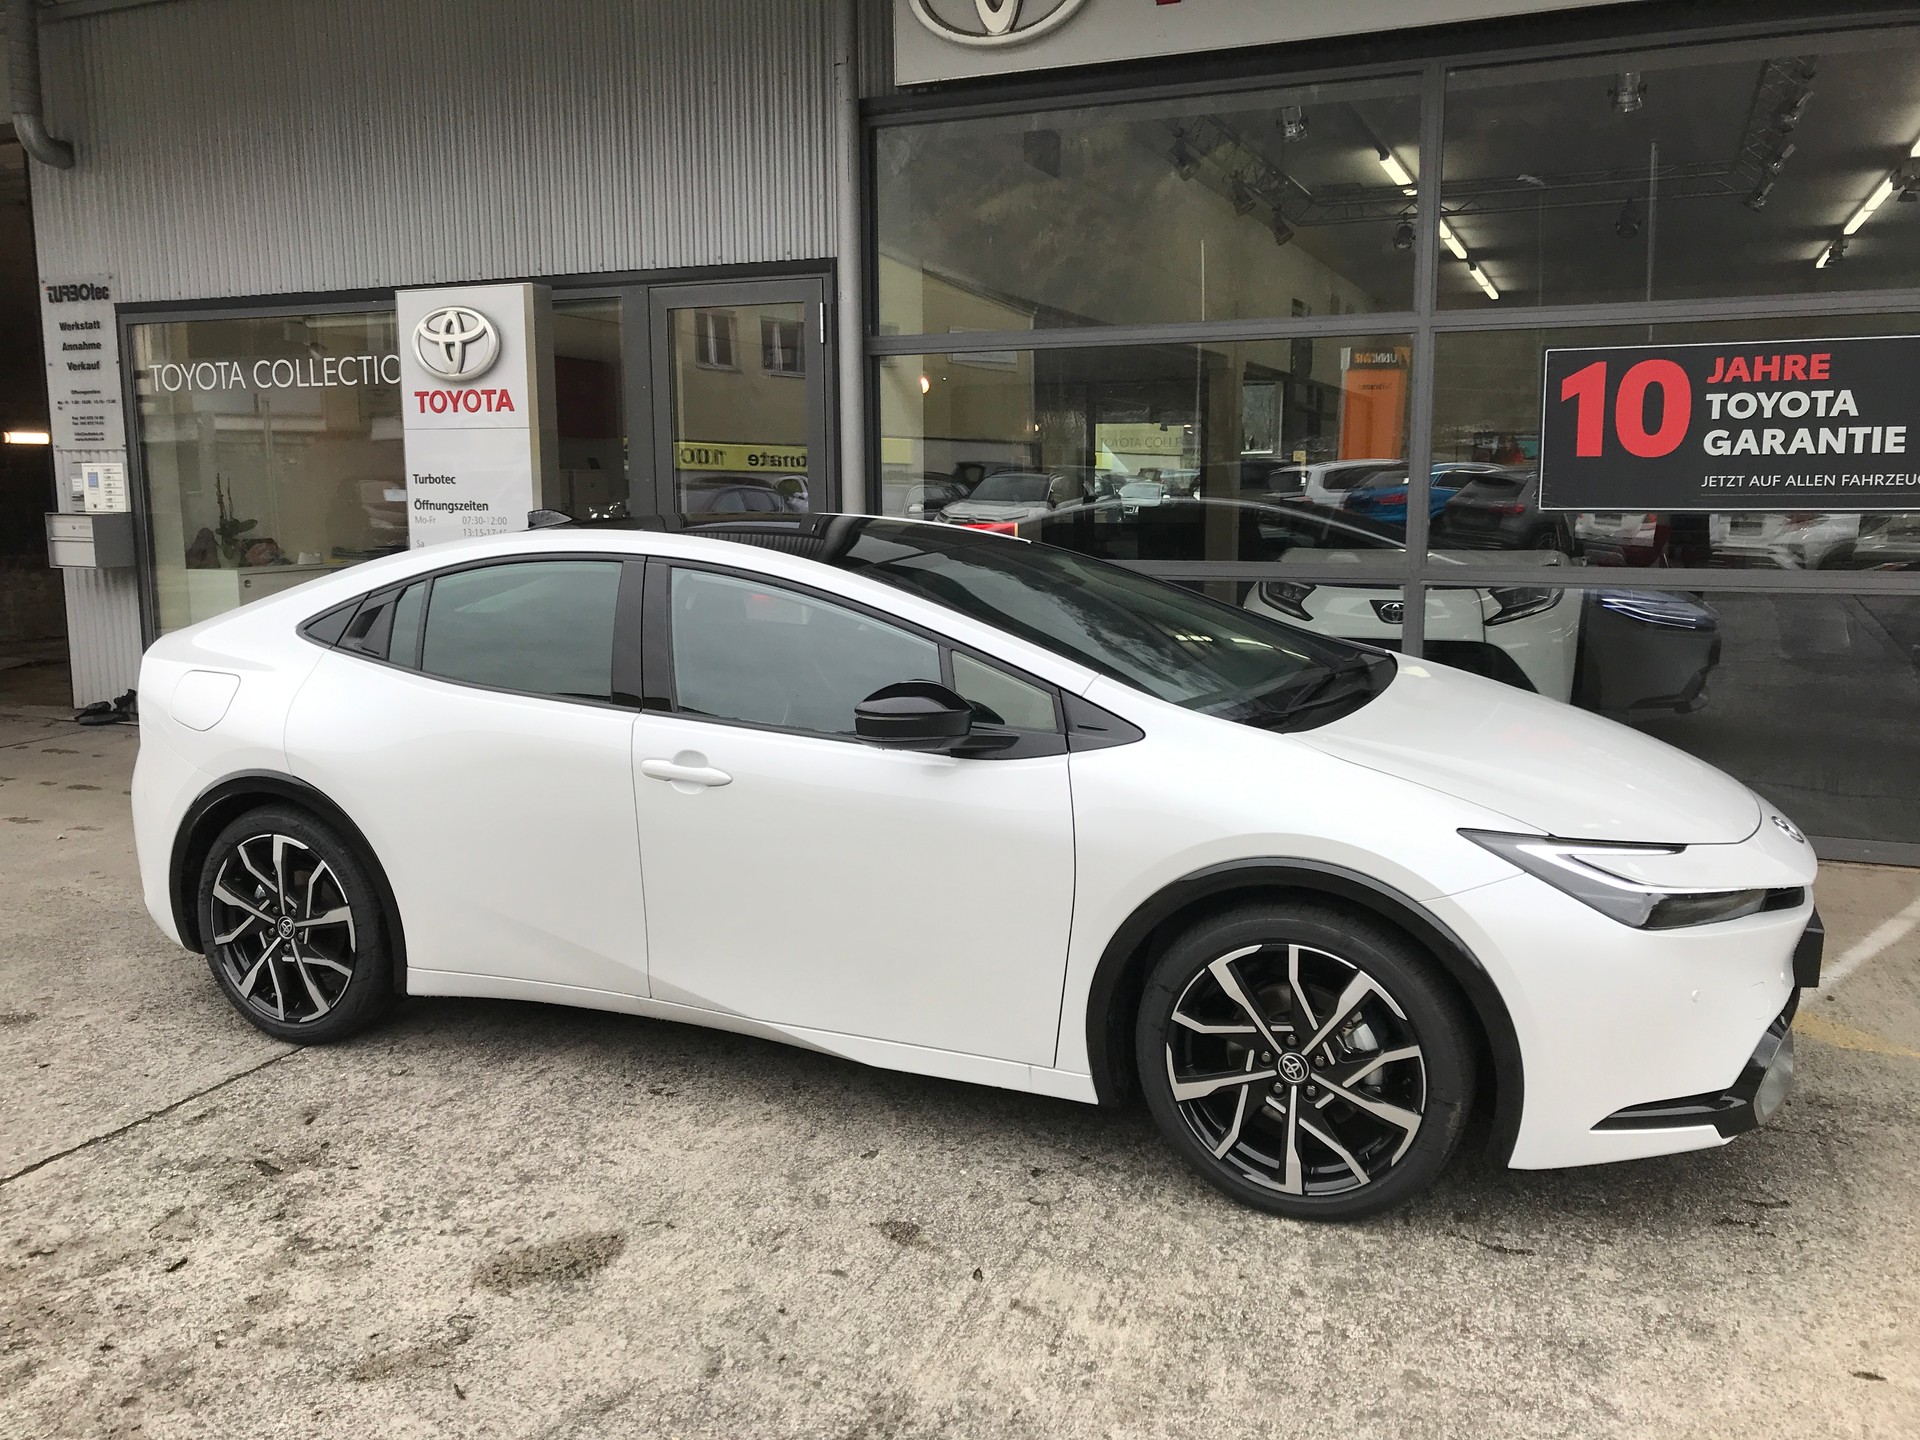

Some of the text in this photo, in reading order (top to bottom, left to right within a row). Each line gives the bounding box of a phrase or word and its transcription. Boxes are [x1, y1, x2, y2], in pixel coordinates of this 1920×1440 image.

[59, 320, 101, 331] Werkstatt
[62, 341, 102, 351] Annahme
[66, 360, 100, 371] Verkauf
[149, 361, 246, 391] TOYOTA
[414, 389, 515, 413] TOYOTA
[1561, 353, 1831, 458] 10 JAHRE
[1705, 390, 1859, 419] TOYOTA
[1100, 437, 1142, 448] TOYOTA
[1703, 426, 1907, 456] GARANTIE
[413, 474, 456, 485] Turbotec
[1701, 473, 1920, 487] JETZT AUF ALLEN FAHRZEU
[414, 498, 489, 513] Öffnungszeiten
[415, 516, 437, 524] Mo-Fr
[416, 540, 425, 548] Sa
